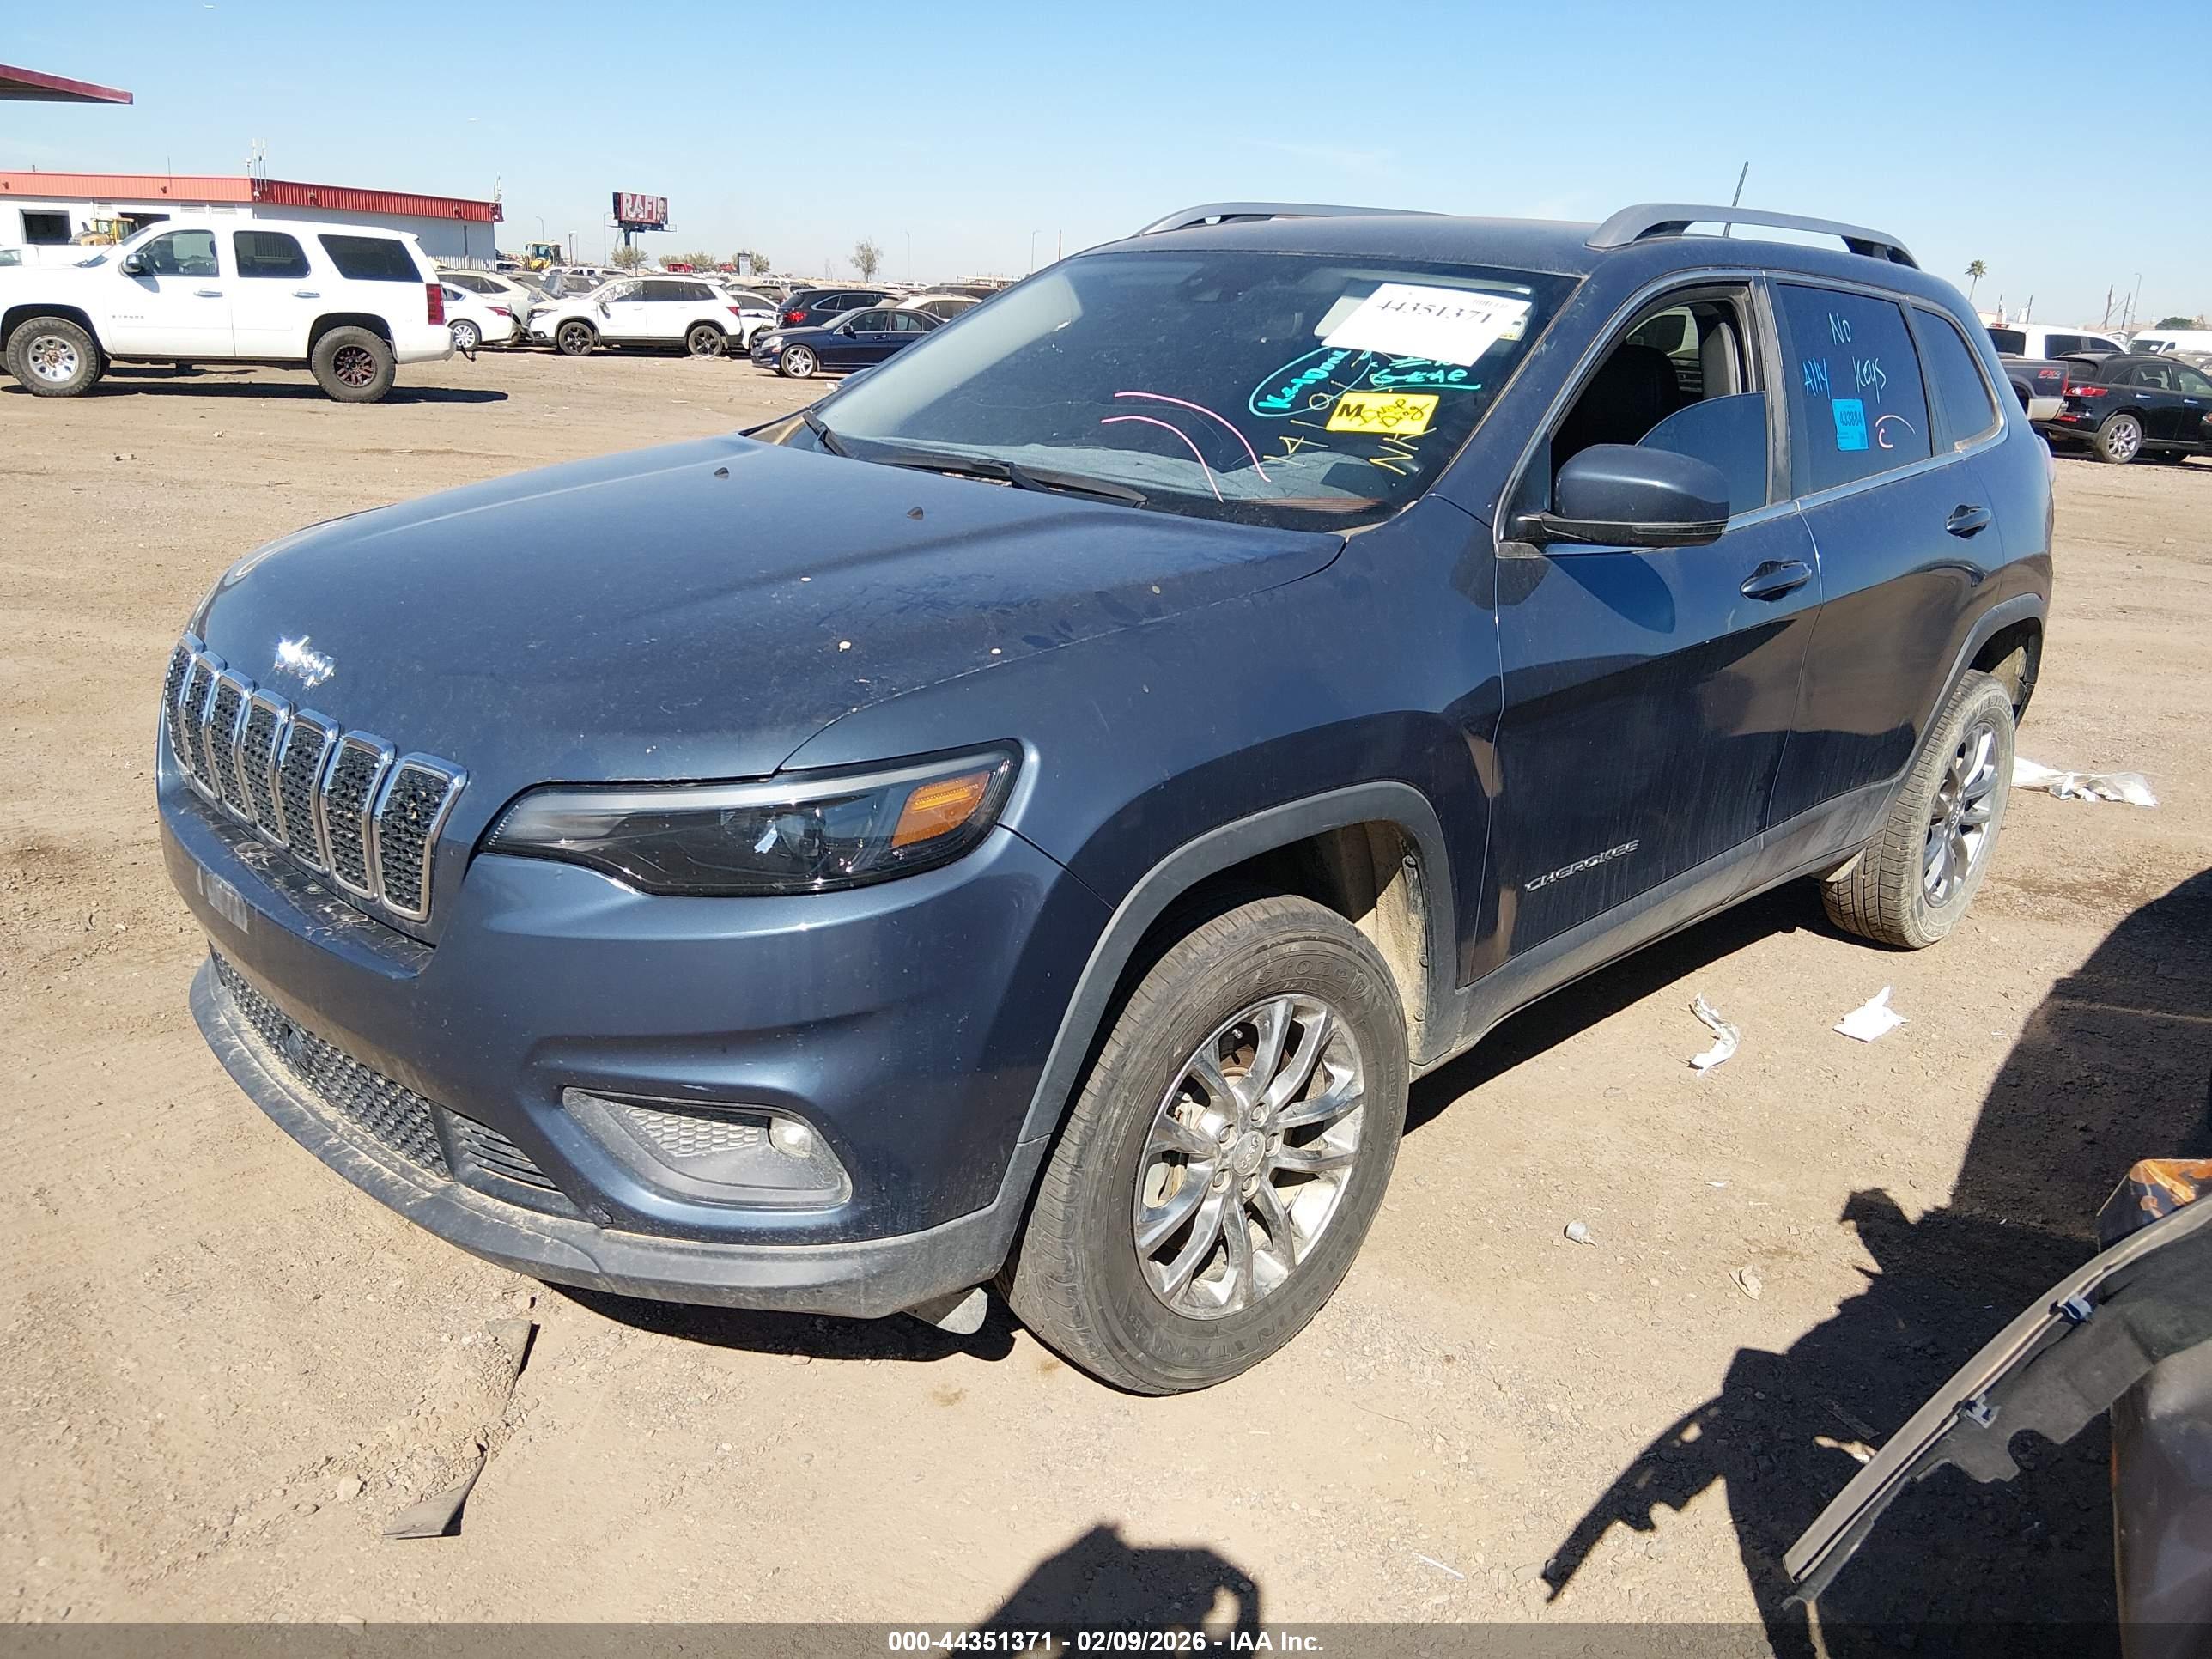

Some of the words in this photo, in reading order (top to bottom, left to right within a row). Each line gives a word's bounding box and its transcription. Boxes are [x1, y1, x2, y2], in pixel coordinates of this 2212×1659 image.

[1376, 299, 1493, 324] 44351371
[1828, 312, 1852, 345] No
[1336, 404, 1366, 417] M
[1524, 839, 1639, 892] CHEROKEE
